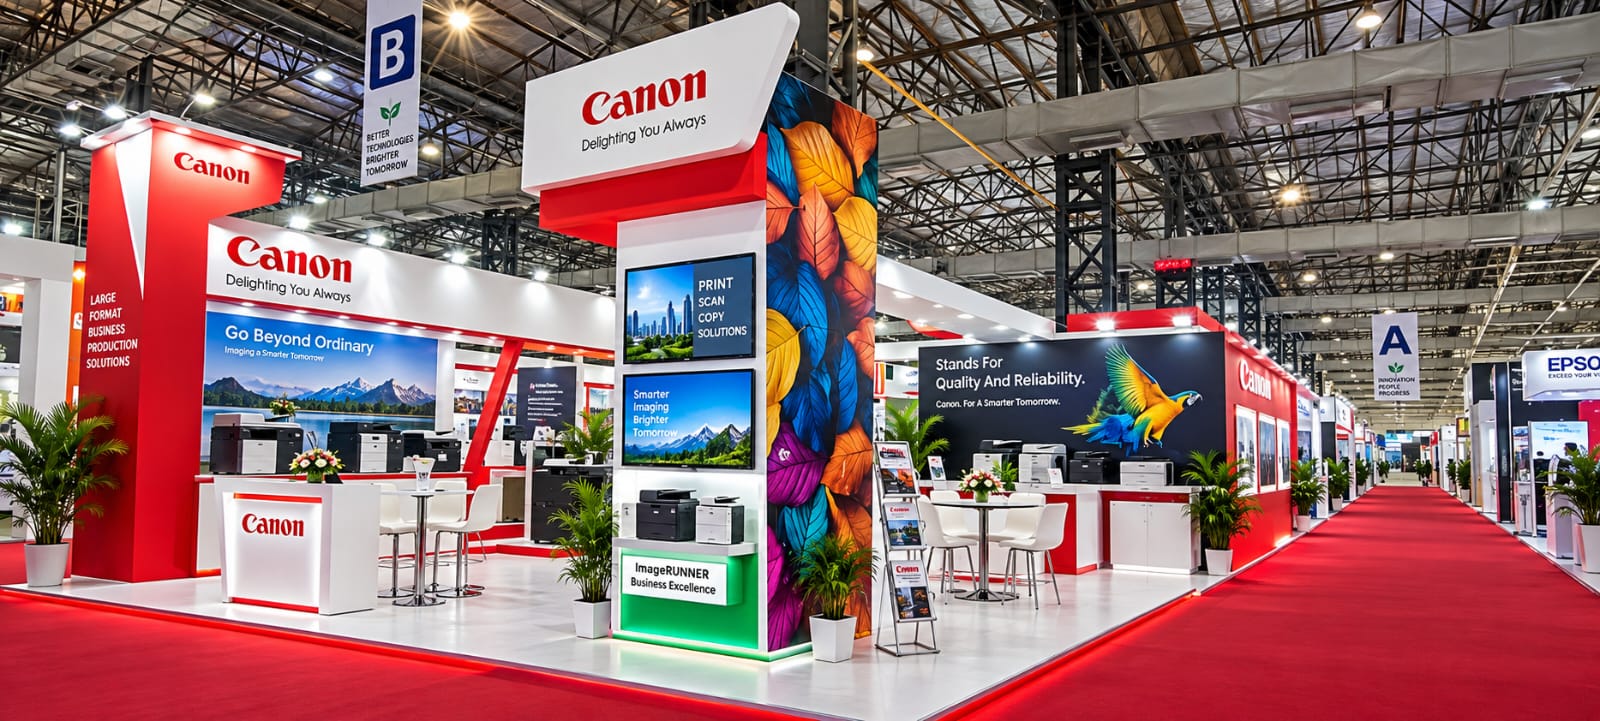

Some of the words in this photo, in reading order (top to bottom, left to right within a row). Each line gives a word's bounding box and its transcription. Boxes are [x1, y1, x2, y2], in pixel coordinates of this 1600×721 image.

[379, 29, 405, 80] B
[581, 69, 707, 126] Canon
[367, 129, 390, 142] BETTER
[581, 129, 636, 152] Delighting
[639, 123, 660, 138] You
[663, 113, 707, 133] Always
[366, 134, 414, 153] TECHNOLOGIES
[366, 150, 399, 165] BRIGHTER
[174, 152, 250, 184] Canon
[365, 159, 409, 176] TOMORROW
[226, 235, 352, 283] Canon
[226, 274, 287, 295] Delighting
[289, 284, 310, 297] You
[313, 287, 351, 303] Always
[698, 276, 734, 292] PRINT
[90, 292, 116, 306] LARGE
[698, 296, 725, 307] SCAN
[89, 308, 122, 321] FORMAT
[698, 311, 724, 323] COPY
[88, 324, 126, 337] BUSINESS
[698, 326, 747, 338] SOLUTIONS
[87, 338, 138, 353] PRODUCTION
[224, 325, 249, 341] Go
[253, 328, 311, 348] Beyond
[315, 336, 374, 357] Ordinary
[1379, 325, 1412, 355] A
[224, 346, 255, 357] Imaging
[262, 349, 289, 359] Smarter
[290, 352, 324, 361] Tomorrow
[86, 355, 130, 369] SOLUTIONS
[936, 357, 980, 371] Stands
[982, 356, 1003, 369] For
[936, 376, 981, 391] Quality
[984, 374, 1011, 388] And
[1014, 371, 1086, 388] Reliability.
[1239, 359, 1272, 400] Canon
[633, 389, 670, 400] Smarter
[633, 402, 670, 413] Imaging
[963, 399, 975, 408] For
[976, 399, 983, 407] A
[983, 398, 1015, 407] Smarter
[633, 415, 669, 426] Brighter
[633, 428, 678, 438] Tomorrow
[242, 513, 304, 537] Canon
[635, 562, 709, 580] ImageRUNNER
[631, 577, 667, 590] Business
[669, 581, 716, 595] Excellence
